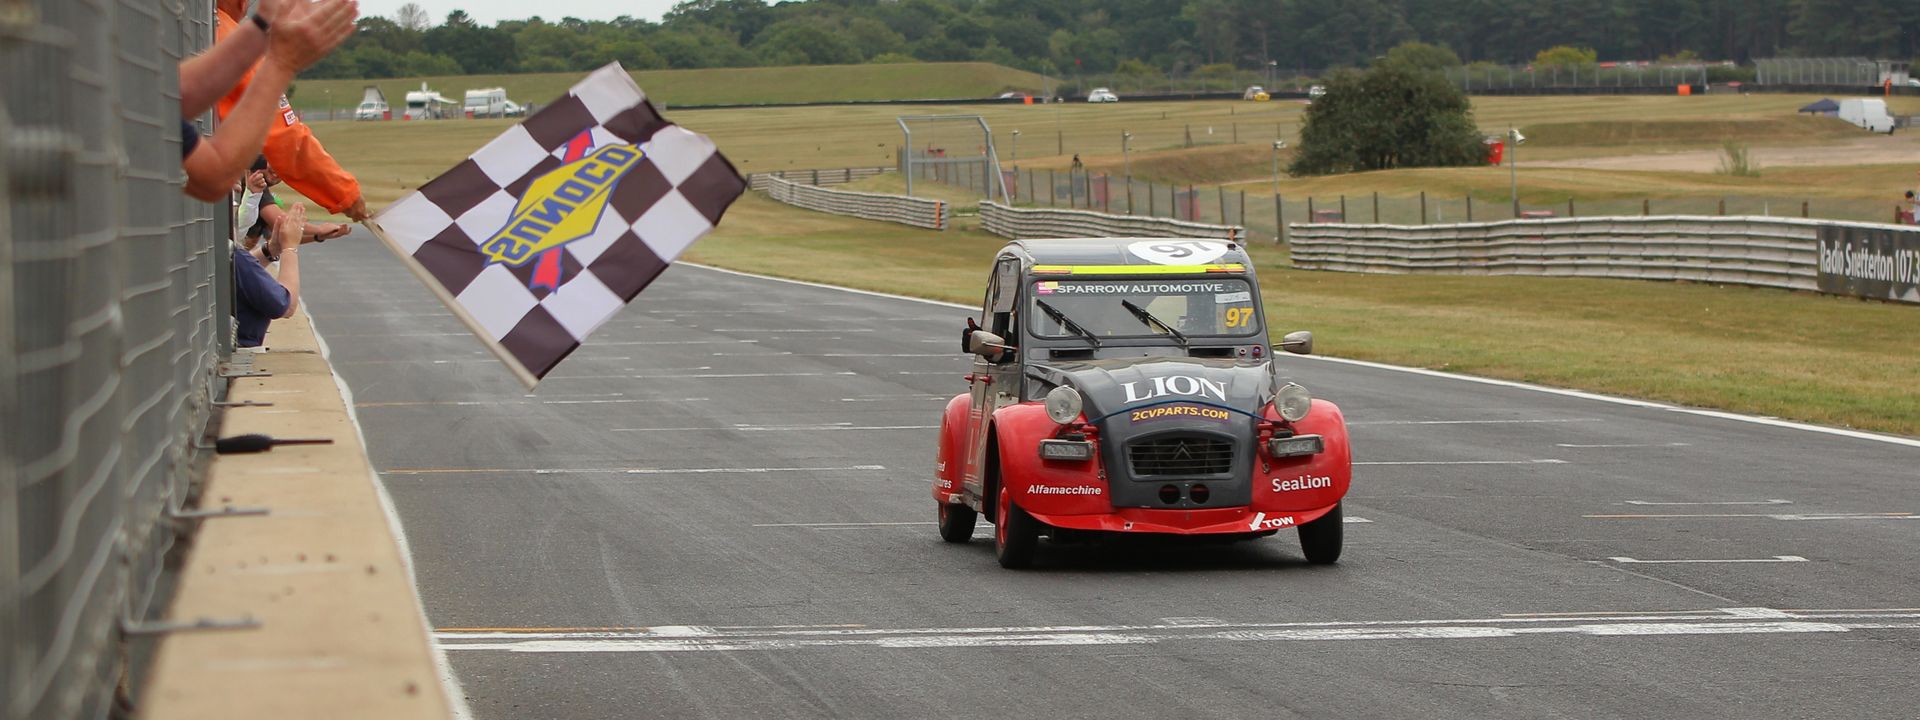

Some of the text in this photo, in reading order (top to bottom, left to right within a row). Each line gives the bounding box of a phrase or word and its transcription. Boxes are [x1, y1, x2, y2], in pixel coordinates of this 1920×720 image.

[1150, 242, 1212, 258] 97
[1820, 240, 1844, 275] Radio
[1845, 243, 1893, 282] Snetterton
[1057, 284, 1129, 294] SPARROW
[1131, 283, 1224, 293] AUTOMOTIVE
[1225, 307, 1254, 327] 97
[1120, 375, 1227, 404] LION
[1132, 406, 1229, 421] 2CVPARTS.COM
[1027, 484, 1102, 495] Alfamacchine
[1272, 475, 1331, 492] SeaLion
[1263, 516, 1294, 528] TOW
